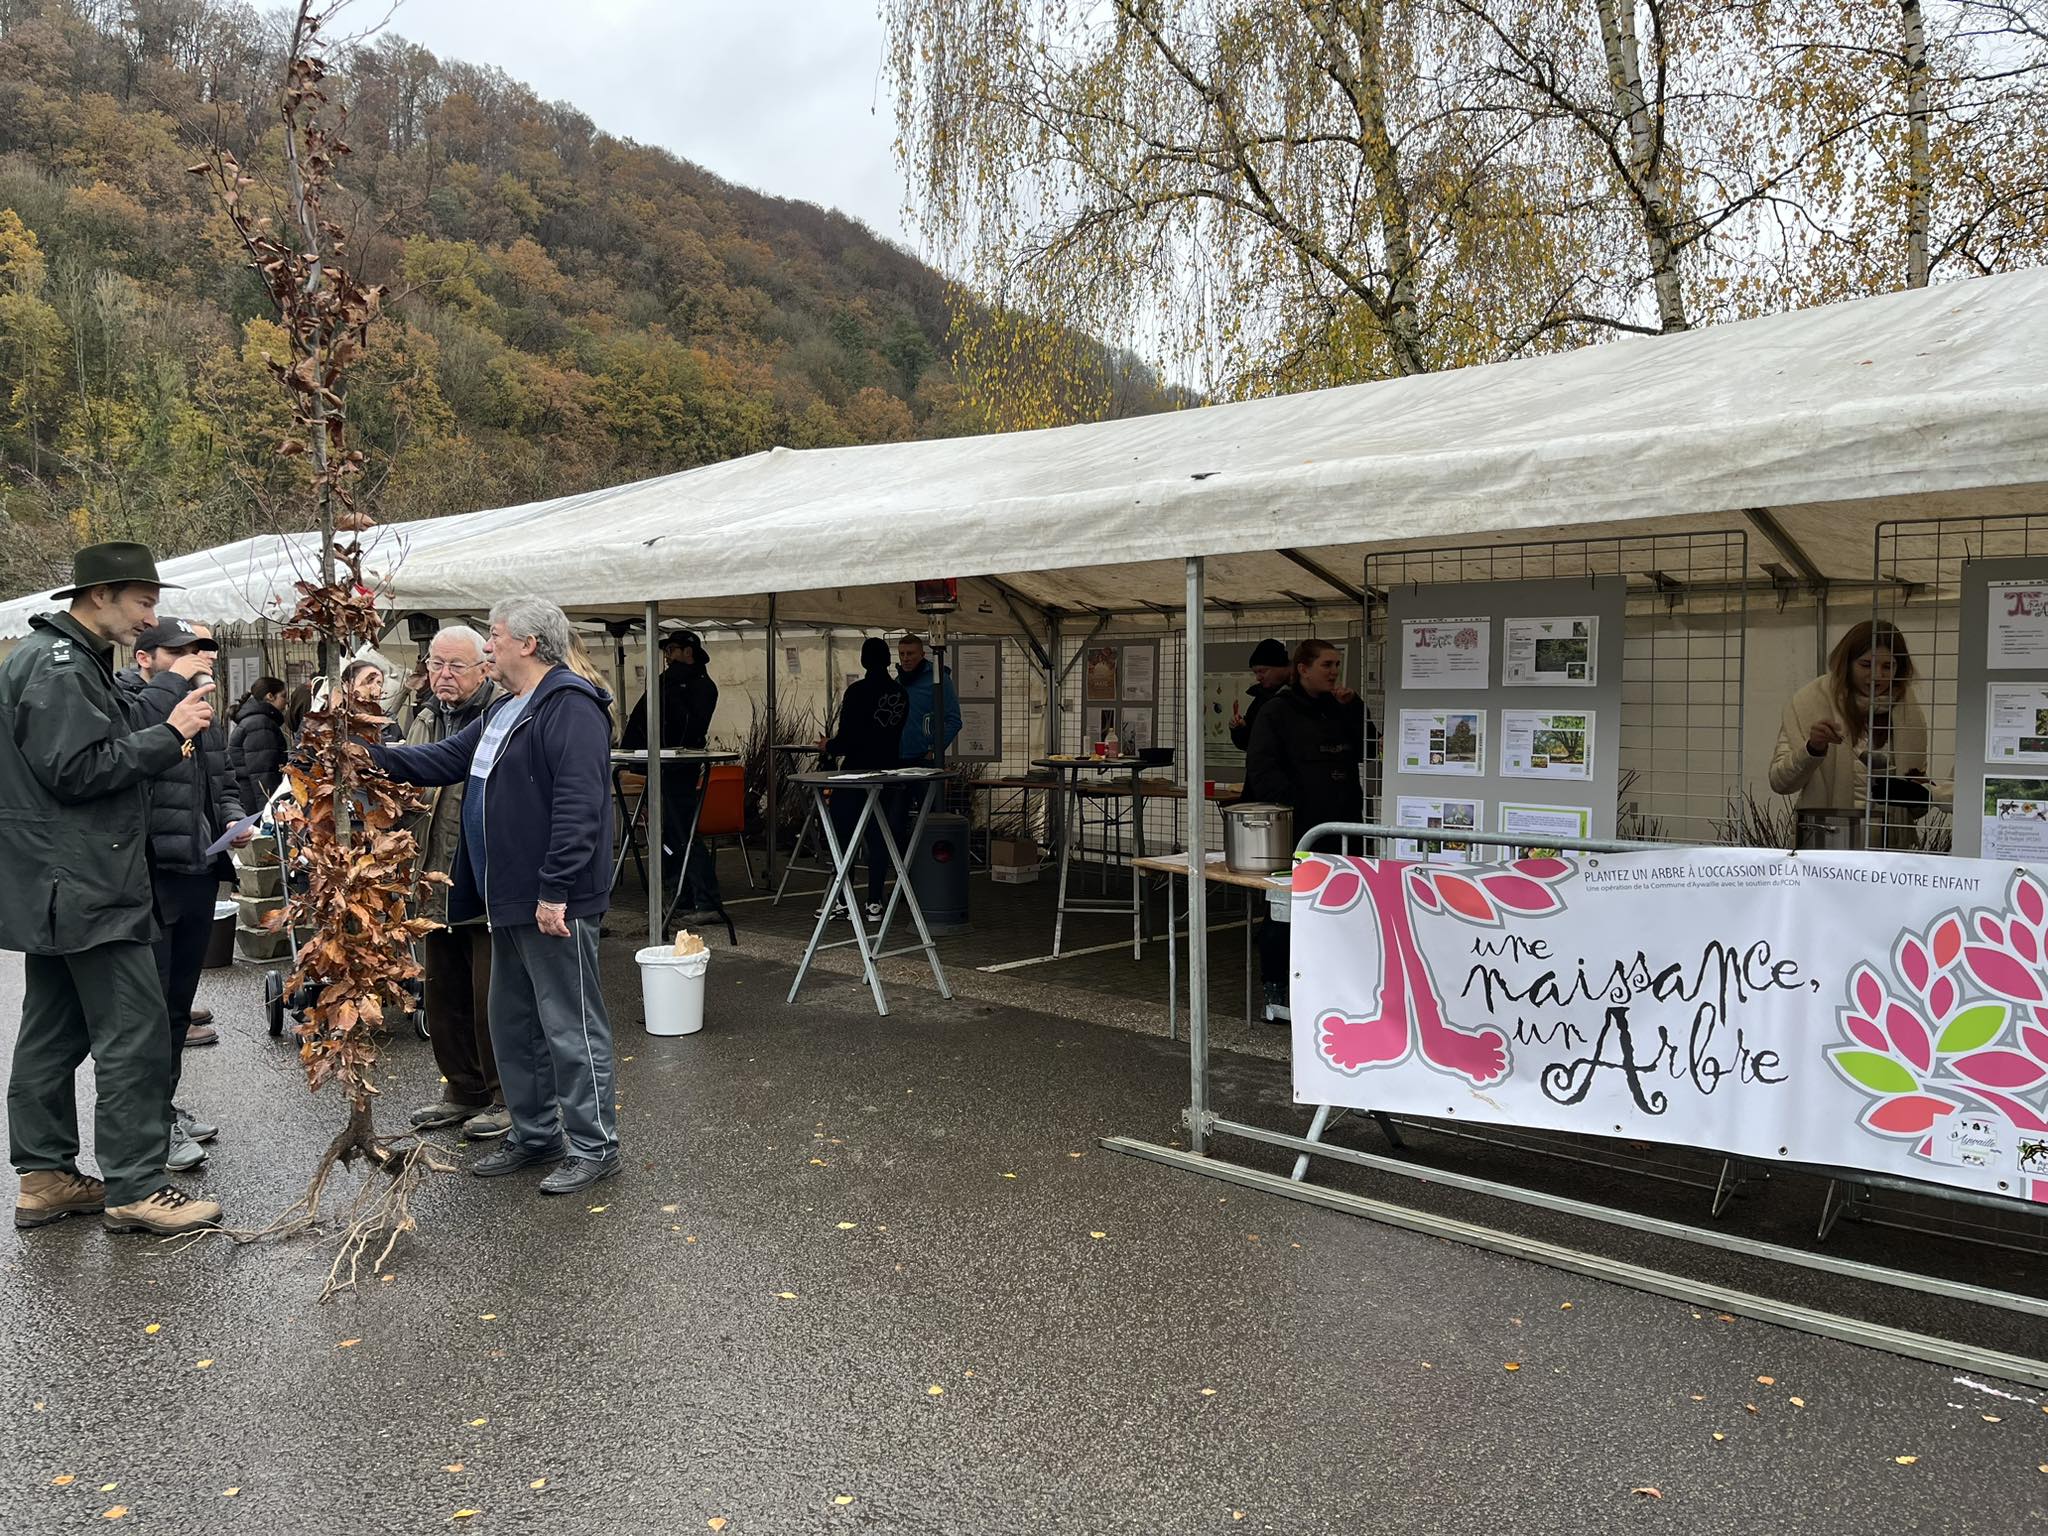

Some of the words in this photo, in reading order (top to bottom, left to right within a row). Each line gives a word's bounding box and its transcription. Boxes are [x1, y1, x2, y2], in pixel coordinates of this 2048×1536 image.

[1584, 869, 1629, 882] PLANTEZ
[1632, 868, 1648, 881] UN
[1651, 867, 1685, 879] ARBRE
[1688, 864, 1695, 878] À
[1698, 865, 1766, 878] L'OCCASSION
[1769, 864, 1783, 876] DE
[1784, 864, 1798, 876] LA
[1802, 865, 1868, 882] NAISSANCE
[1871, 870, 1887, 884] DE
[1889, 871, 1929, 888] VOTRE
[1932, 875, 1981, 892] ENFANT
[1600, 884, 1632, 892] opération
[1470, 934, 1554, 963] une
[1512, 1016, 1588, 1050] un
[1540, 1001, 1789, 1116] Arbre
